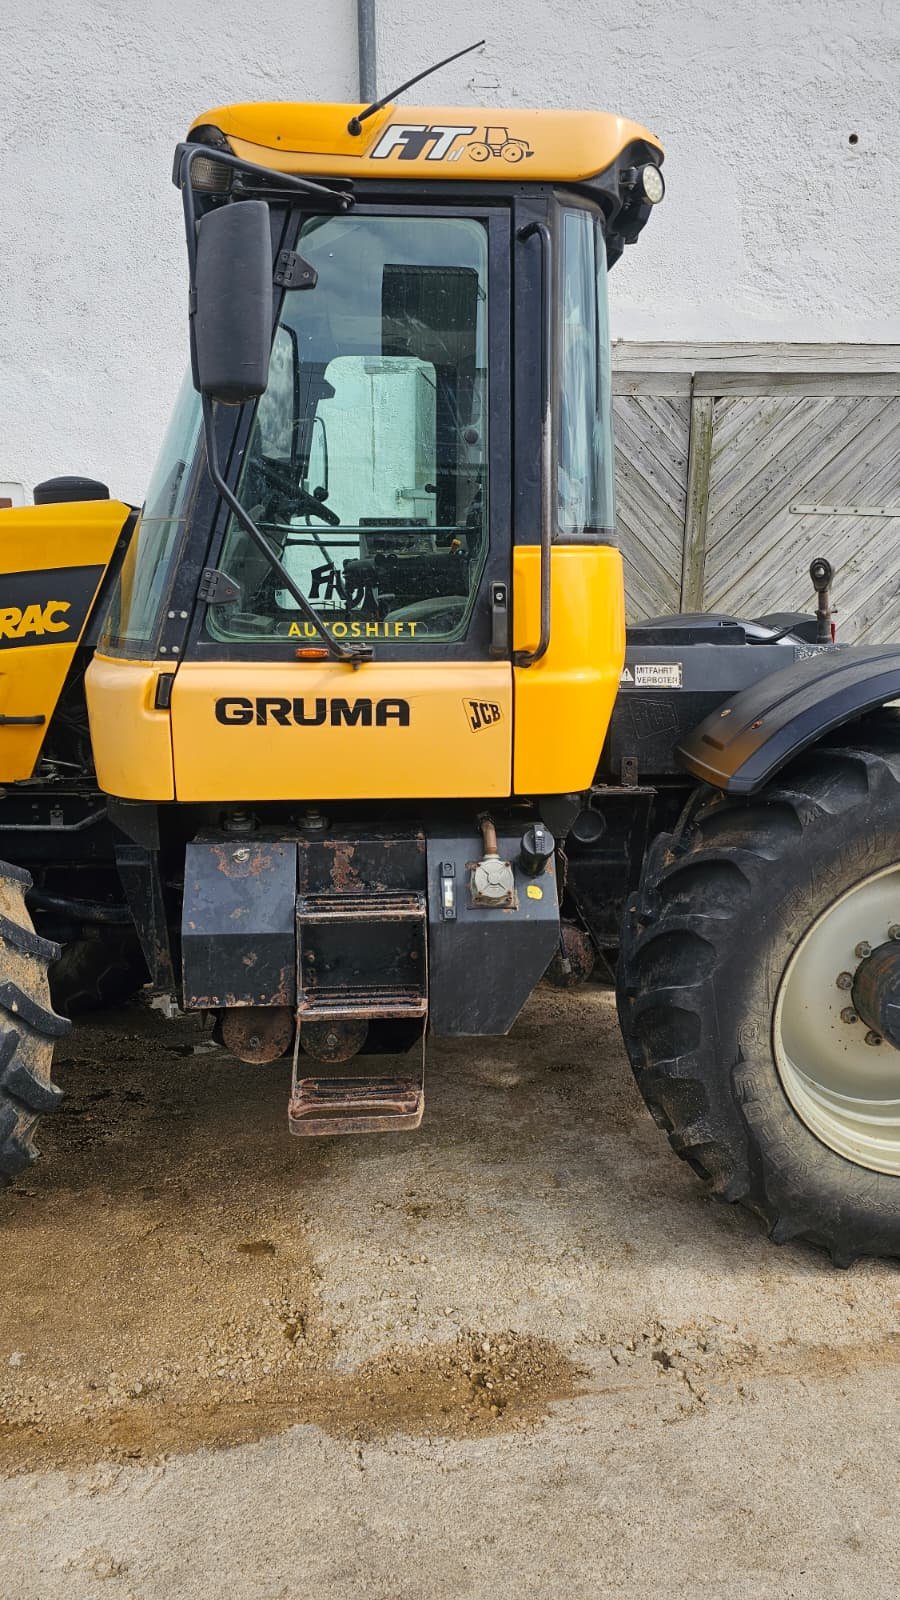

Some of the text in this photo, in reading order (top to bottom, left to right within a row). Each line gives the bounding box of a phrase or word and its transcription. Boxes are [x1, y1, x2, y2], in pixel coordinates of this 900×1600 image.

[636, 666, 673, 674] MITFAHRT
[215, 697, 410, 727] GRUMA
[469, 701, 501, 730] JCB
